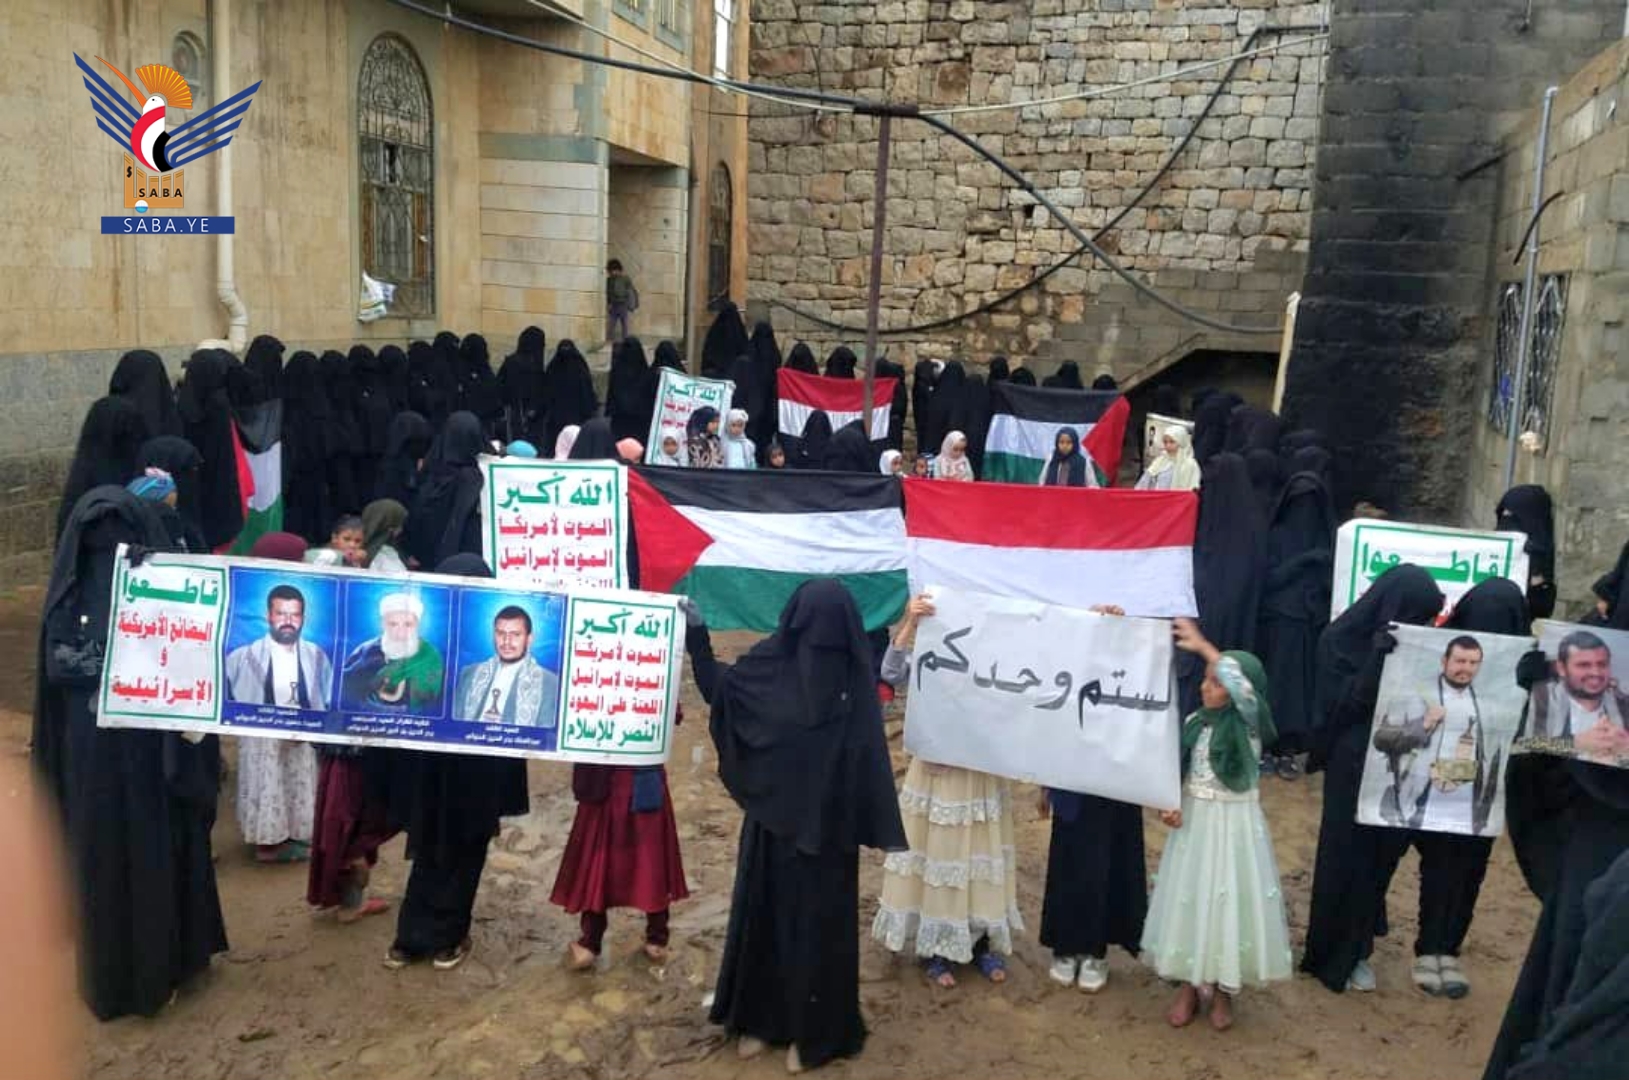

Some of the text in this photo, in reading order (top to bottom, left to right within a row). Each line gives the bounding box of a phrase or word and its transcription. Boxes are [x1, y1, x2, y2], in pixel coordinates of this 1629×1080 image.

[497, 471, 612, 512] الله أكبر
[564, 518, 613, 540] الموت
[564, 549, 613, 571] الموت
[1361, 542, 1499, 584] قاطعوا
[122, 570, 219, 606] قاطعوا
[169, 615, 213, 645] البضائع
[576, 607, 670, 640] الله أكبر
[626, 648, 666, 667] الموت
[624, 673, 665, 692] الموت
[916, 626, 1172, 730] لستم وحدكم
[569, 695, 663, 716] اللعنة على اليهود
[618, 719, 662, 747] النصر
